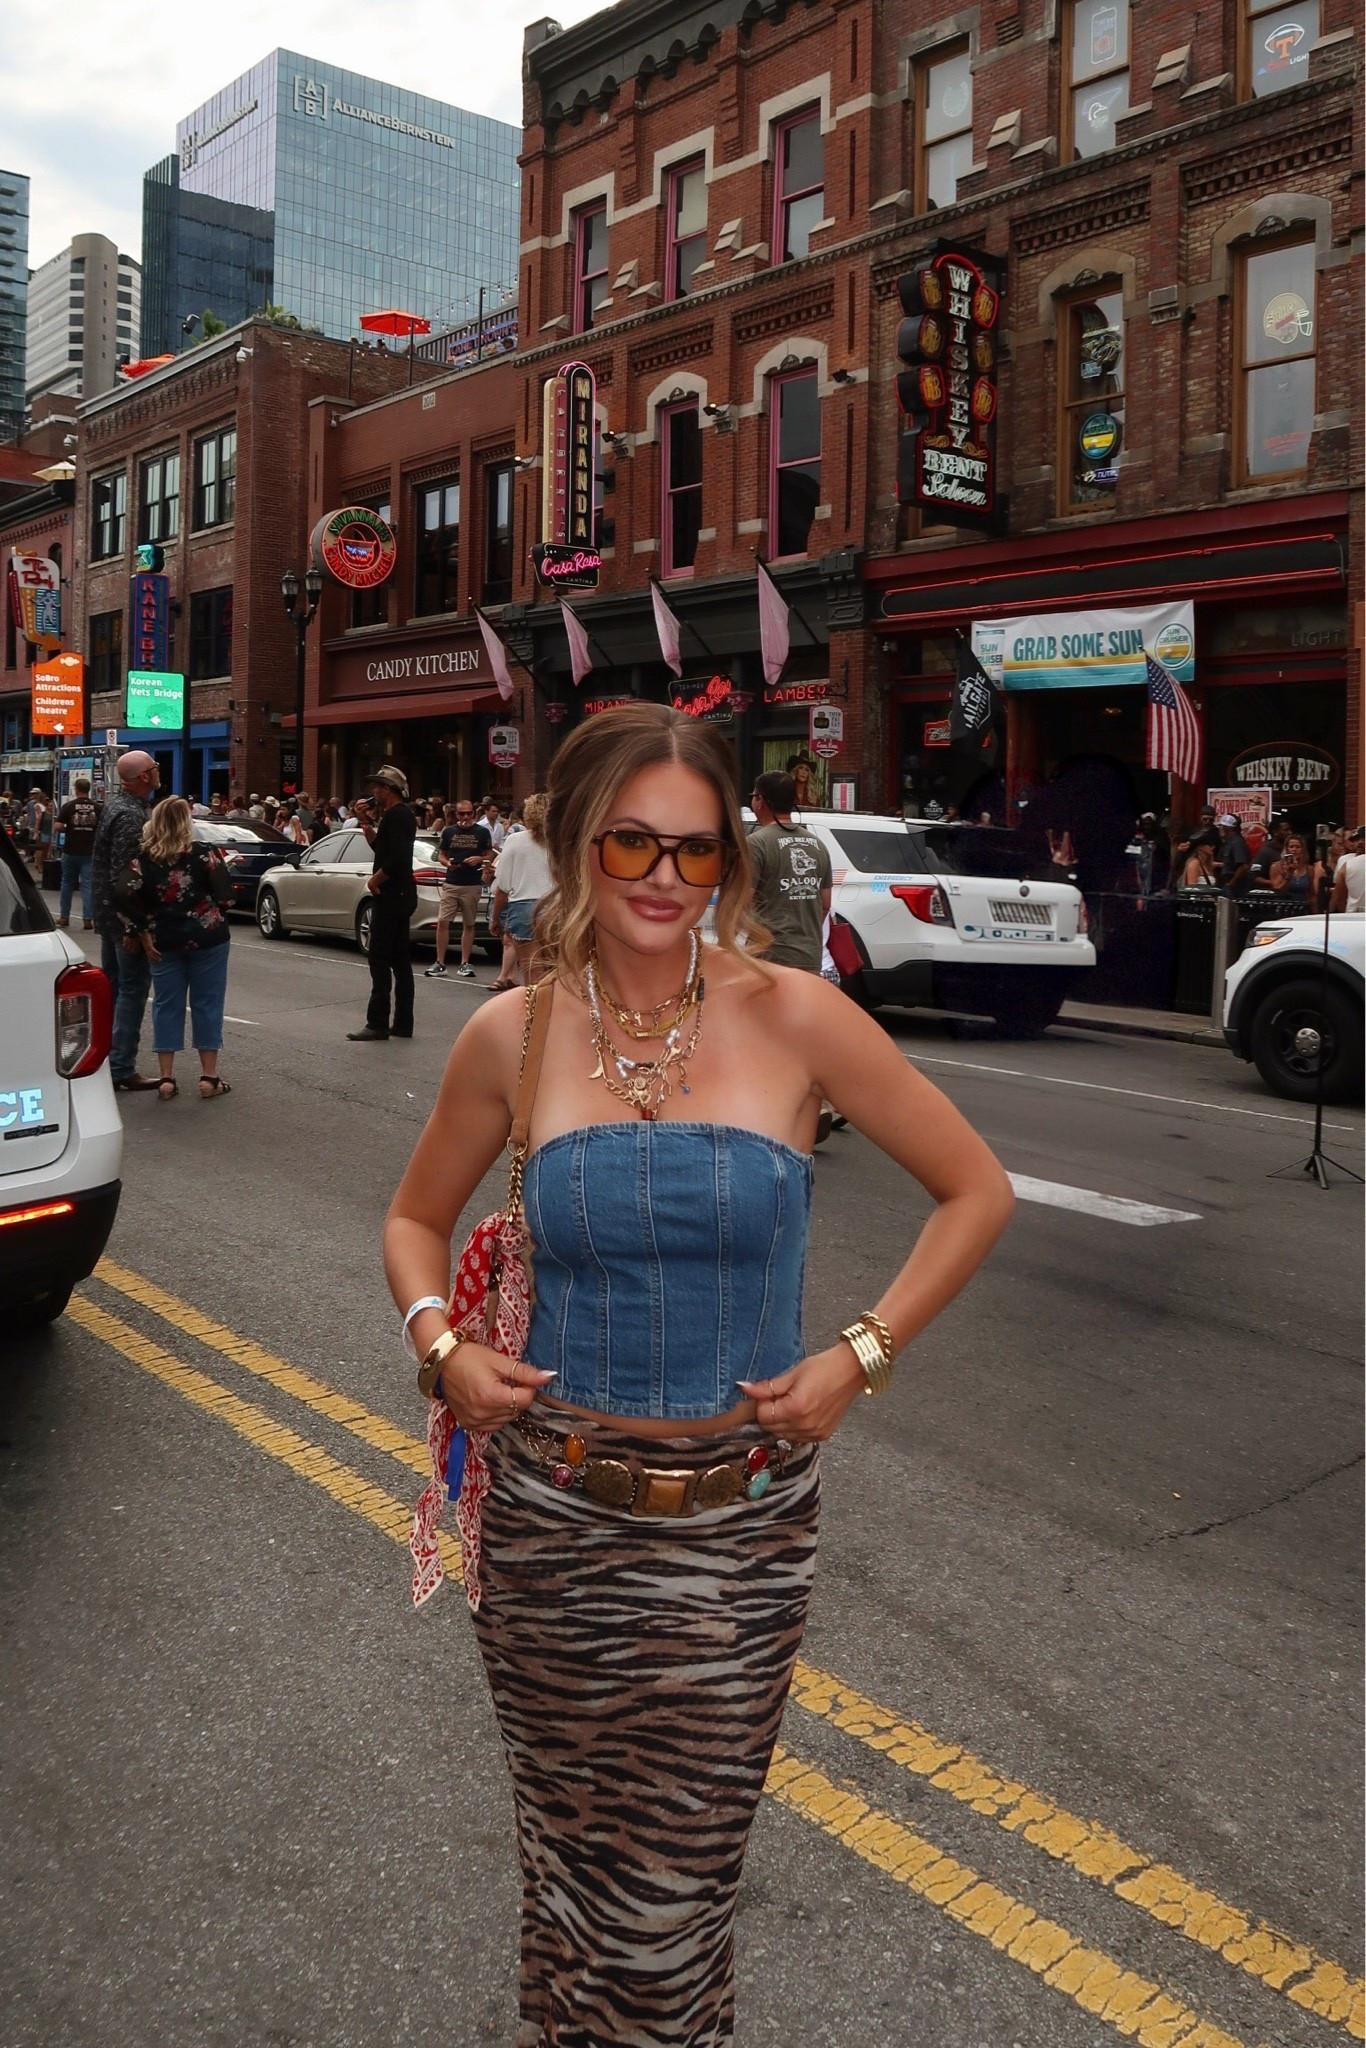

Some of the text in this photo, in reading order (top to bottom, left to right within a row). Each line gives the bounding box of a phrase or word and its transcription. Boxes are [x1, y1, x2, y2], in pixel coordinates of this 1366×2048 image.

[947, 263, 974, 449] WHISKEY
[575, 376, 591, 538] MIRANDA
[922, 449, 988, 482] BENT
[922, 472, 987, 506] Saloon
[325, 546, 354, 581] CANDY
[356, 551, 395, 584] KITCHEN
[541, 552, 602, 576] Casa Rosa
[141, 580, 157, 633] KANE
[980, 643, 998, 653] SUN
[1013, 629, 1144, 662] GRAB SOME SUN
[1291, 628, 1344, 647] LIGHT
[367, 650, 480, 682] CANDY KITCHEN
[35, 674, 60, 683] SoBro
[35, 684, 81, 693] Attractions
[130, 677, 162, 686] Korean
[35, 697, 75, 706] Childrens
[130, 688, 183, 699] Vets Bridge
[35, 707, 68, 715] Theatre
[1236, 757, 1331, 781] WHISKEY BENT
